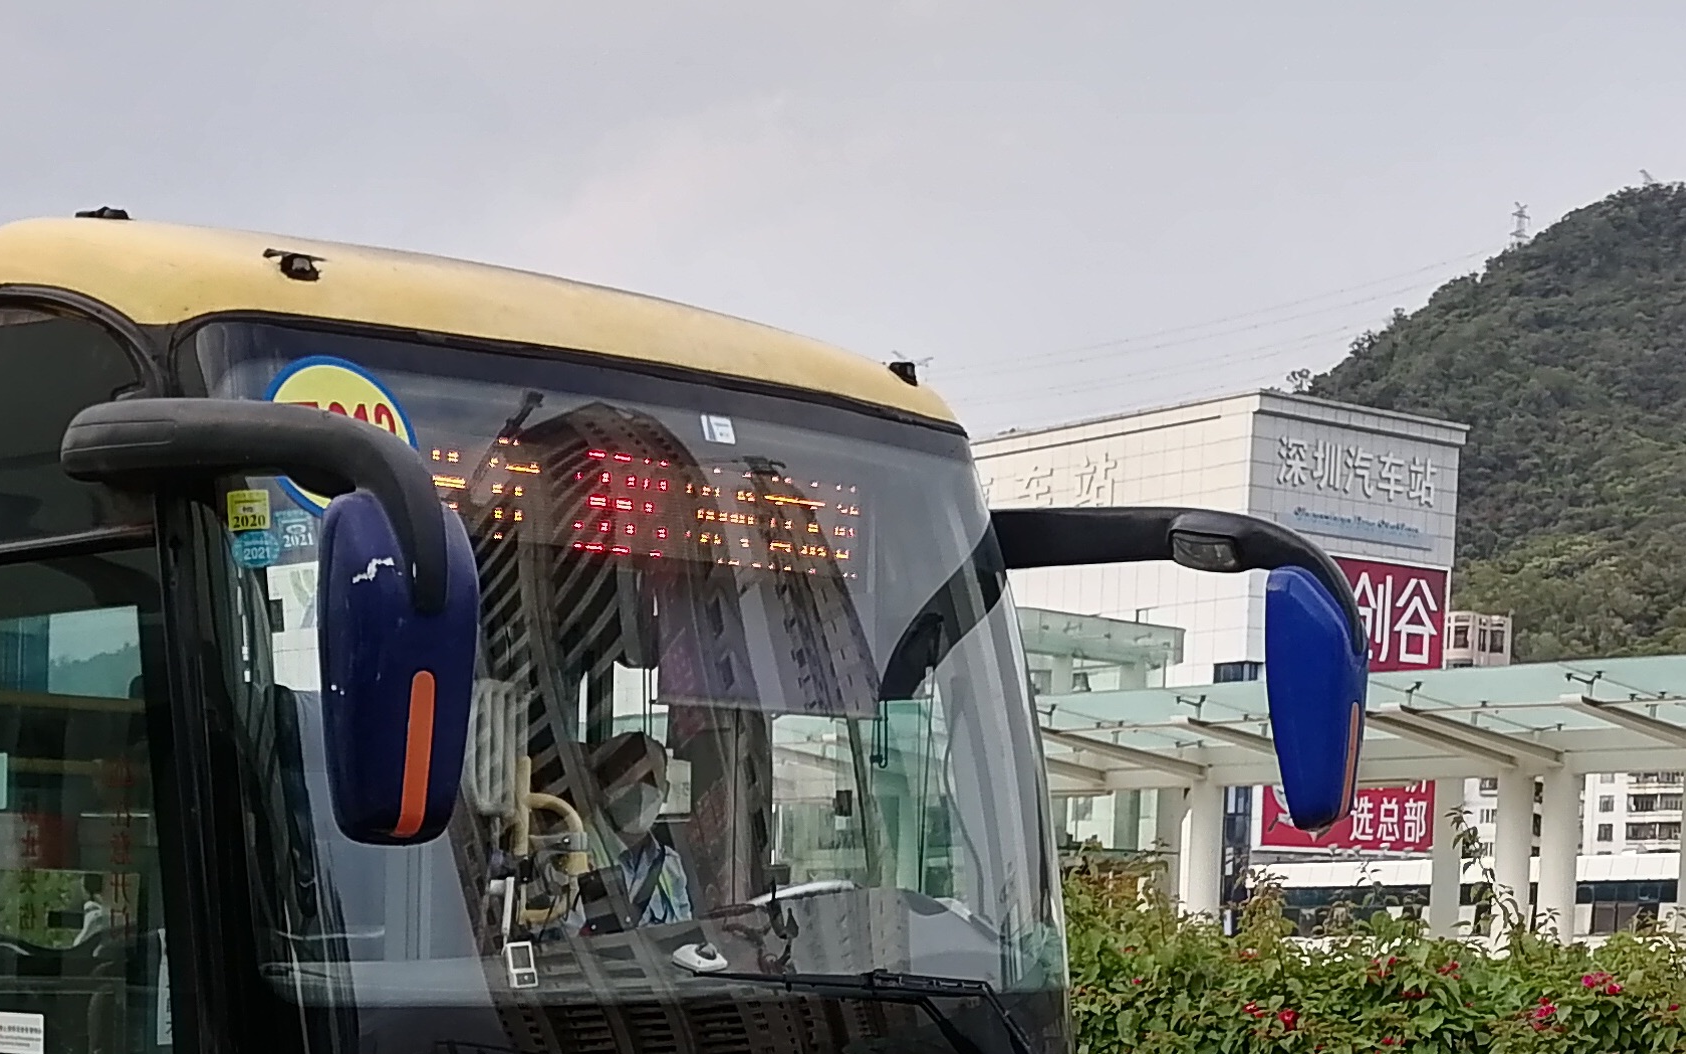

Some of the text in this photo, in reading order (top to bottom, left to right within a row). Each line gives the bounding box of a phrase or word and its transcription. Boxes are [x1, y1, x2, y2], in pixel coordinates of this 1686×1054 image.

[1276, 435, 1438, 509] 深圳汽车站
[233, 513, 266, 530] 2020
[282, 532, 314, 548] 2021
[243, 547, 271, 561] 2021
[1349, 795, 1428, 844] 选总部
